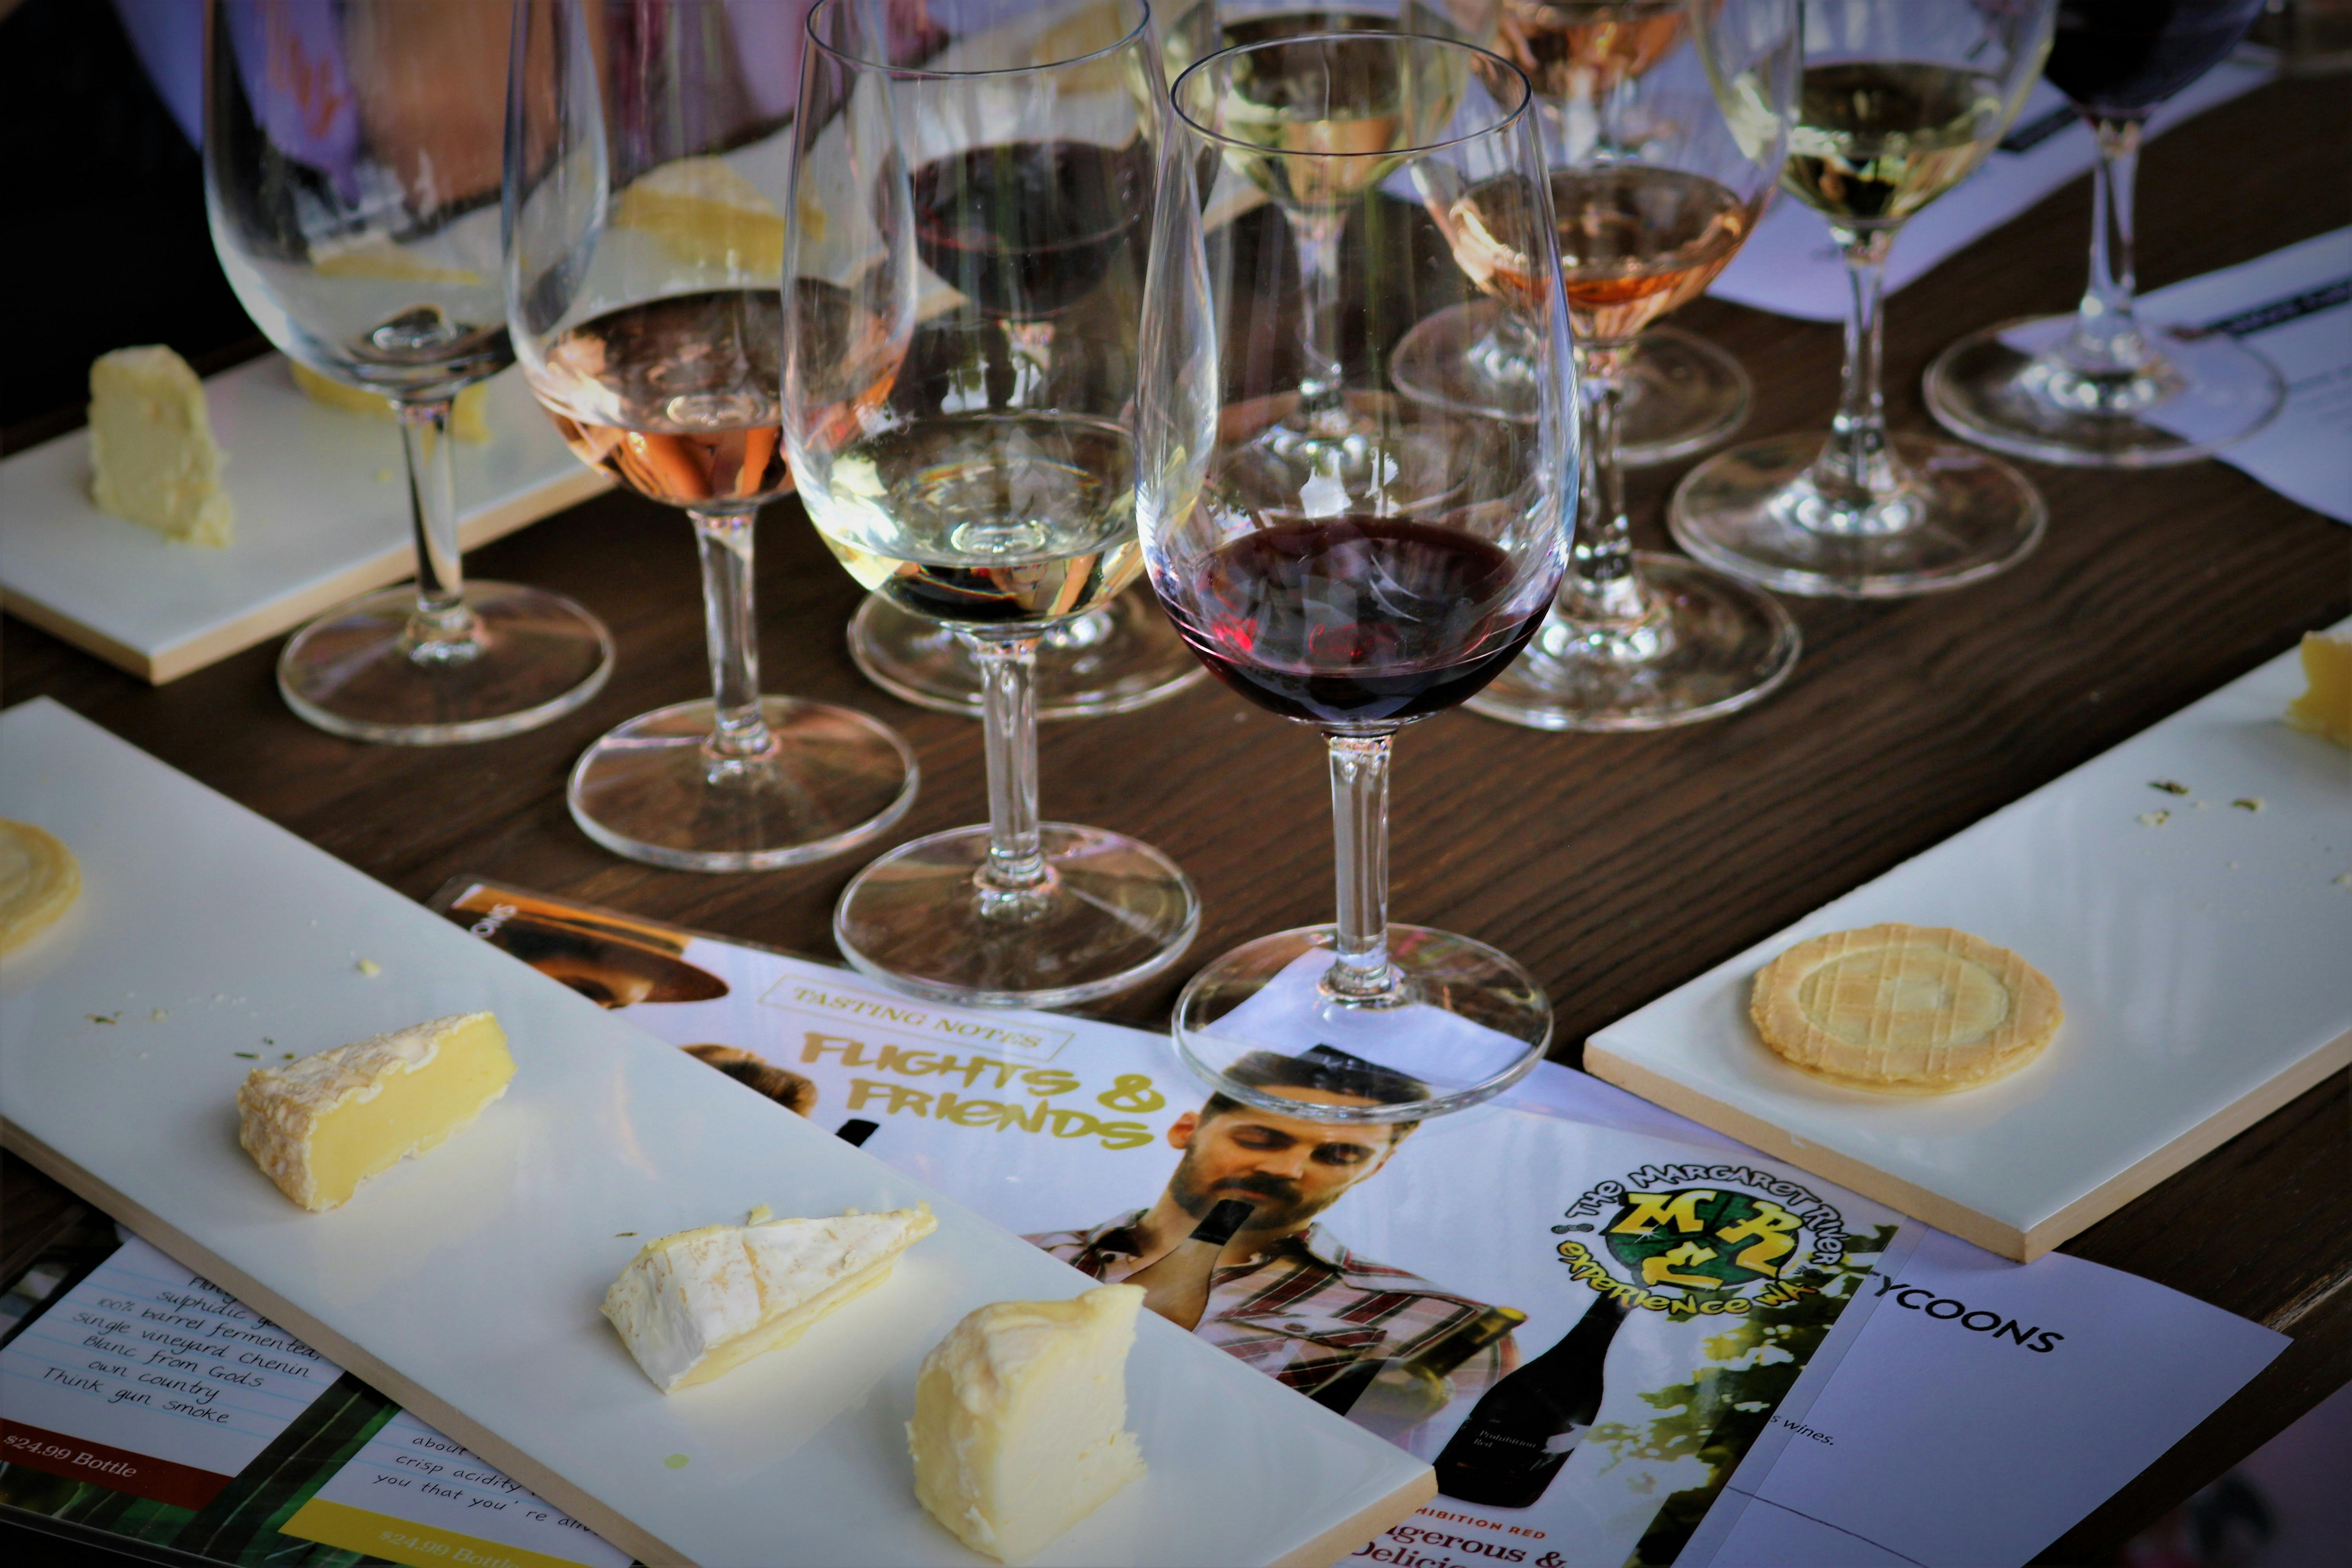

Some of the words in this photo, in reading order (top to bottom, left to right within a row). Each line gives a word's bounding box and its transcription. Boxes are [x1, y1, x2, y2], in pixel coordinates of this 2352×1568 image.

[793, 985, 927, 1026] TASTING
[933, 1019, 1042, 1049] NOTES
[800, 1032, 1081, 1096] FLIGHTS
[1097, 1074, 1165, 1113] &
[97, 1298, 135, 1312] 100%
[142, 1308, 206, 1329] barrel
[156, 1291, 246, 1319] sulphidic
[73, 1312, 131, 1335] single
[143, 1330, 230, 1358] vineyard
[240, 1352, 309, 1378] Chenin
[83, 1336, 135, 1357] Blanc
[143, 1350, 198, 1373] from
[209, 1365, 264, 1387] Gods
[44, 1366, 104, 1393] Think
[108, 1388, 151, 1406] gun
[163, 1400, 229, 1423] smoke
[89, 1361, 127, 1377] own
[139, 1372, 219, 1405] country
[413, 1437, 468, 1455] about
[1473, 1438, 1494, 1449] Red
[1479, 1430, 1537, 1449] Prohibition
[1783, 1414, 1834, 1446] wines.
[4, 1434, 71, 1460] $24.99
[71, 1452, 137, 1477] Bottle
[372, 1474, 411, 1487] you
[422, 1482, 463, 1500] that
[396, 1455, 443, 1474] crisp
[454, 1469, 521, 1494] acidity
[378, 1530, 450, 1556] $24.99
[452, 1547, 520, 1568] Bottle
[1508, 1526, 1546, 1540] RED
[1535, 1551, 1568, 1568] &
